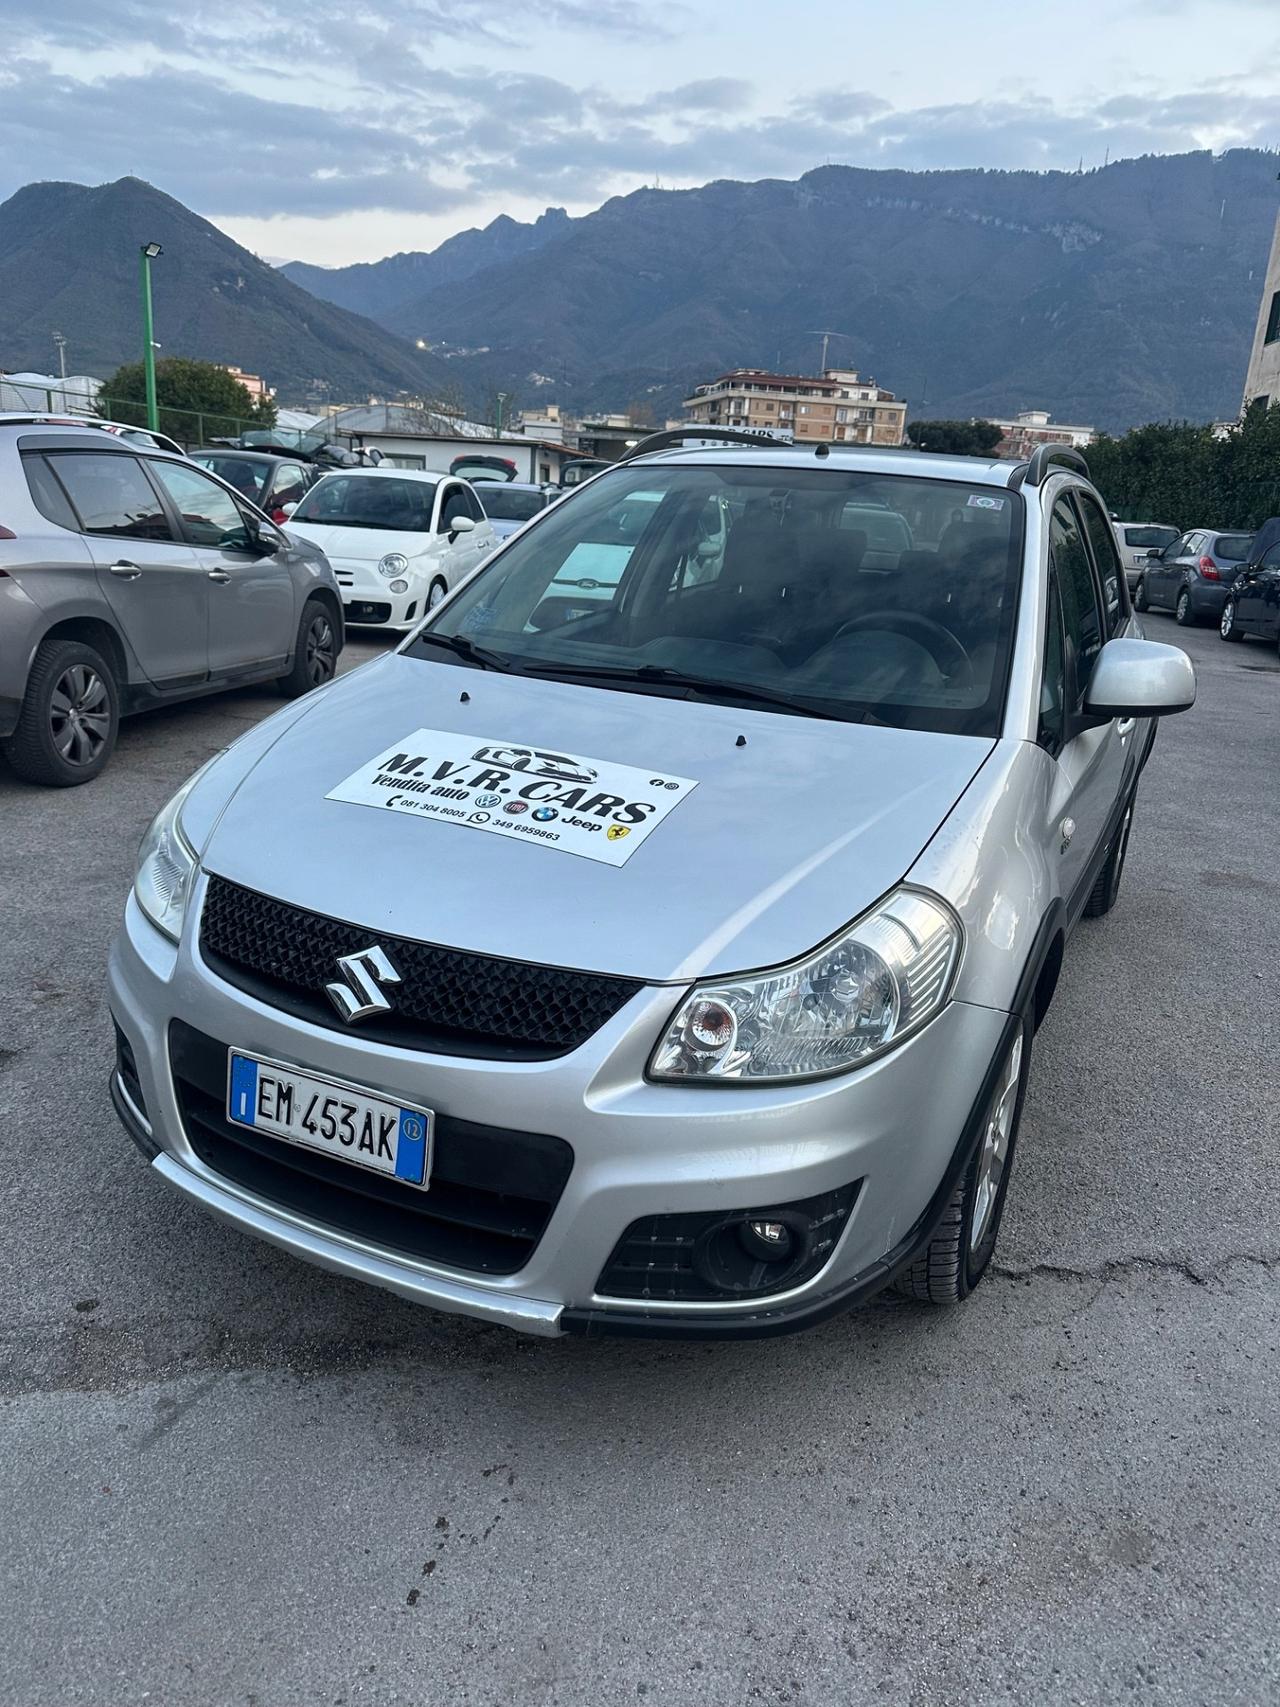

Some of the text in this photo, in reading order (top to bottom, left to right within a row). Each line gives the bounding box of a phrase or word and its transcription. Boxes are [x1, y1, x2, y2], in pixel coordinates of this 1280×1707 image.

[371, 774, 470, 801] Vendita auto
[400, 799, 467, 818] 081 304 8005
[492, 819, 561, 841] 349 6959863
[561, 816, 603, 832] Jeep
[257, 1075, 398, 1161] EM 453AK
[406, 1122, 419, 1138] 12
